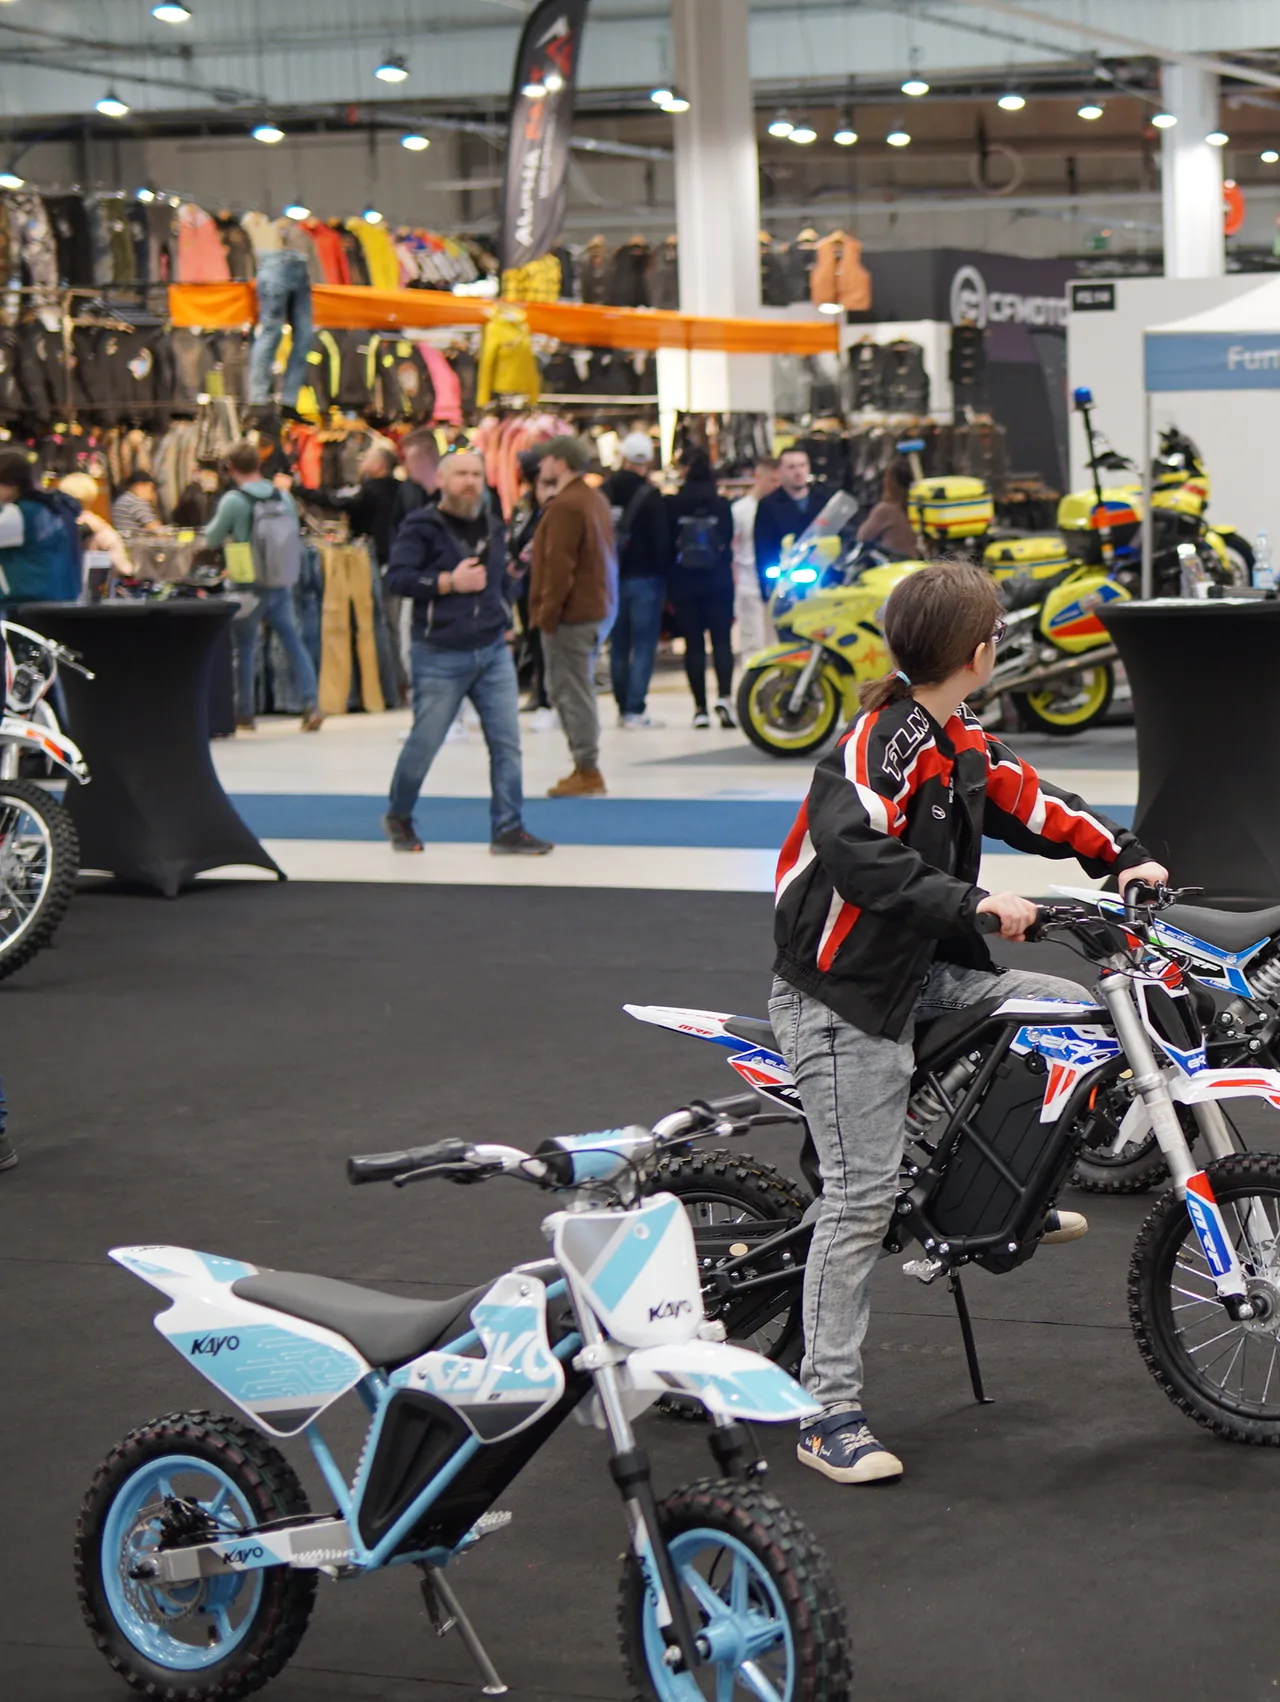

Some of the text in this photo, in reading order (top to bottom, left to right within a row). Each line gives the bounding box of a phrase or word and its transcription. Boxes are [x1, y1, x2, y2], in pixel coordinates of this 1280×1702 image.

[515, 151, 541, 247] ALPHA
[649, 1299, 693, 1323] KAYO
[190, 1333, 240, 1357] KAYO
[406, 1329, 560, 1403] KAYO
[223, 1546, 264, 1565] KAYO
